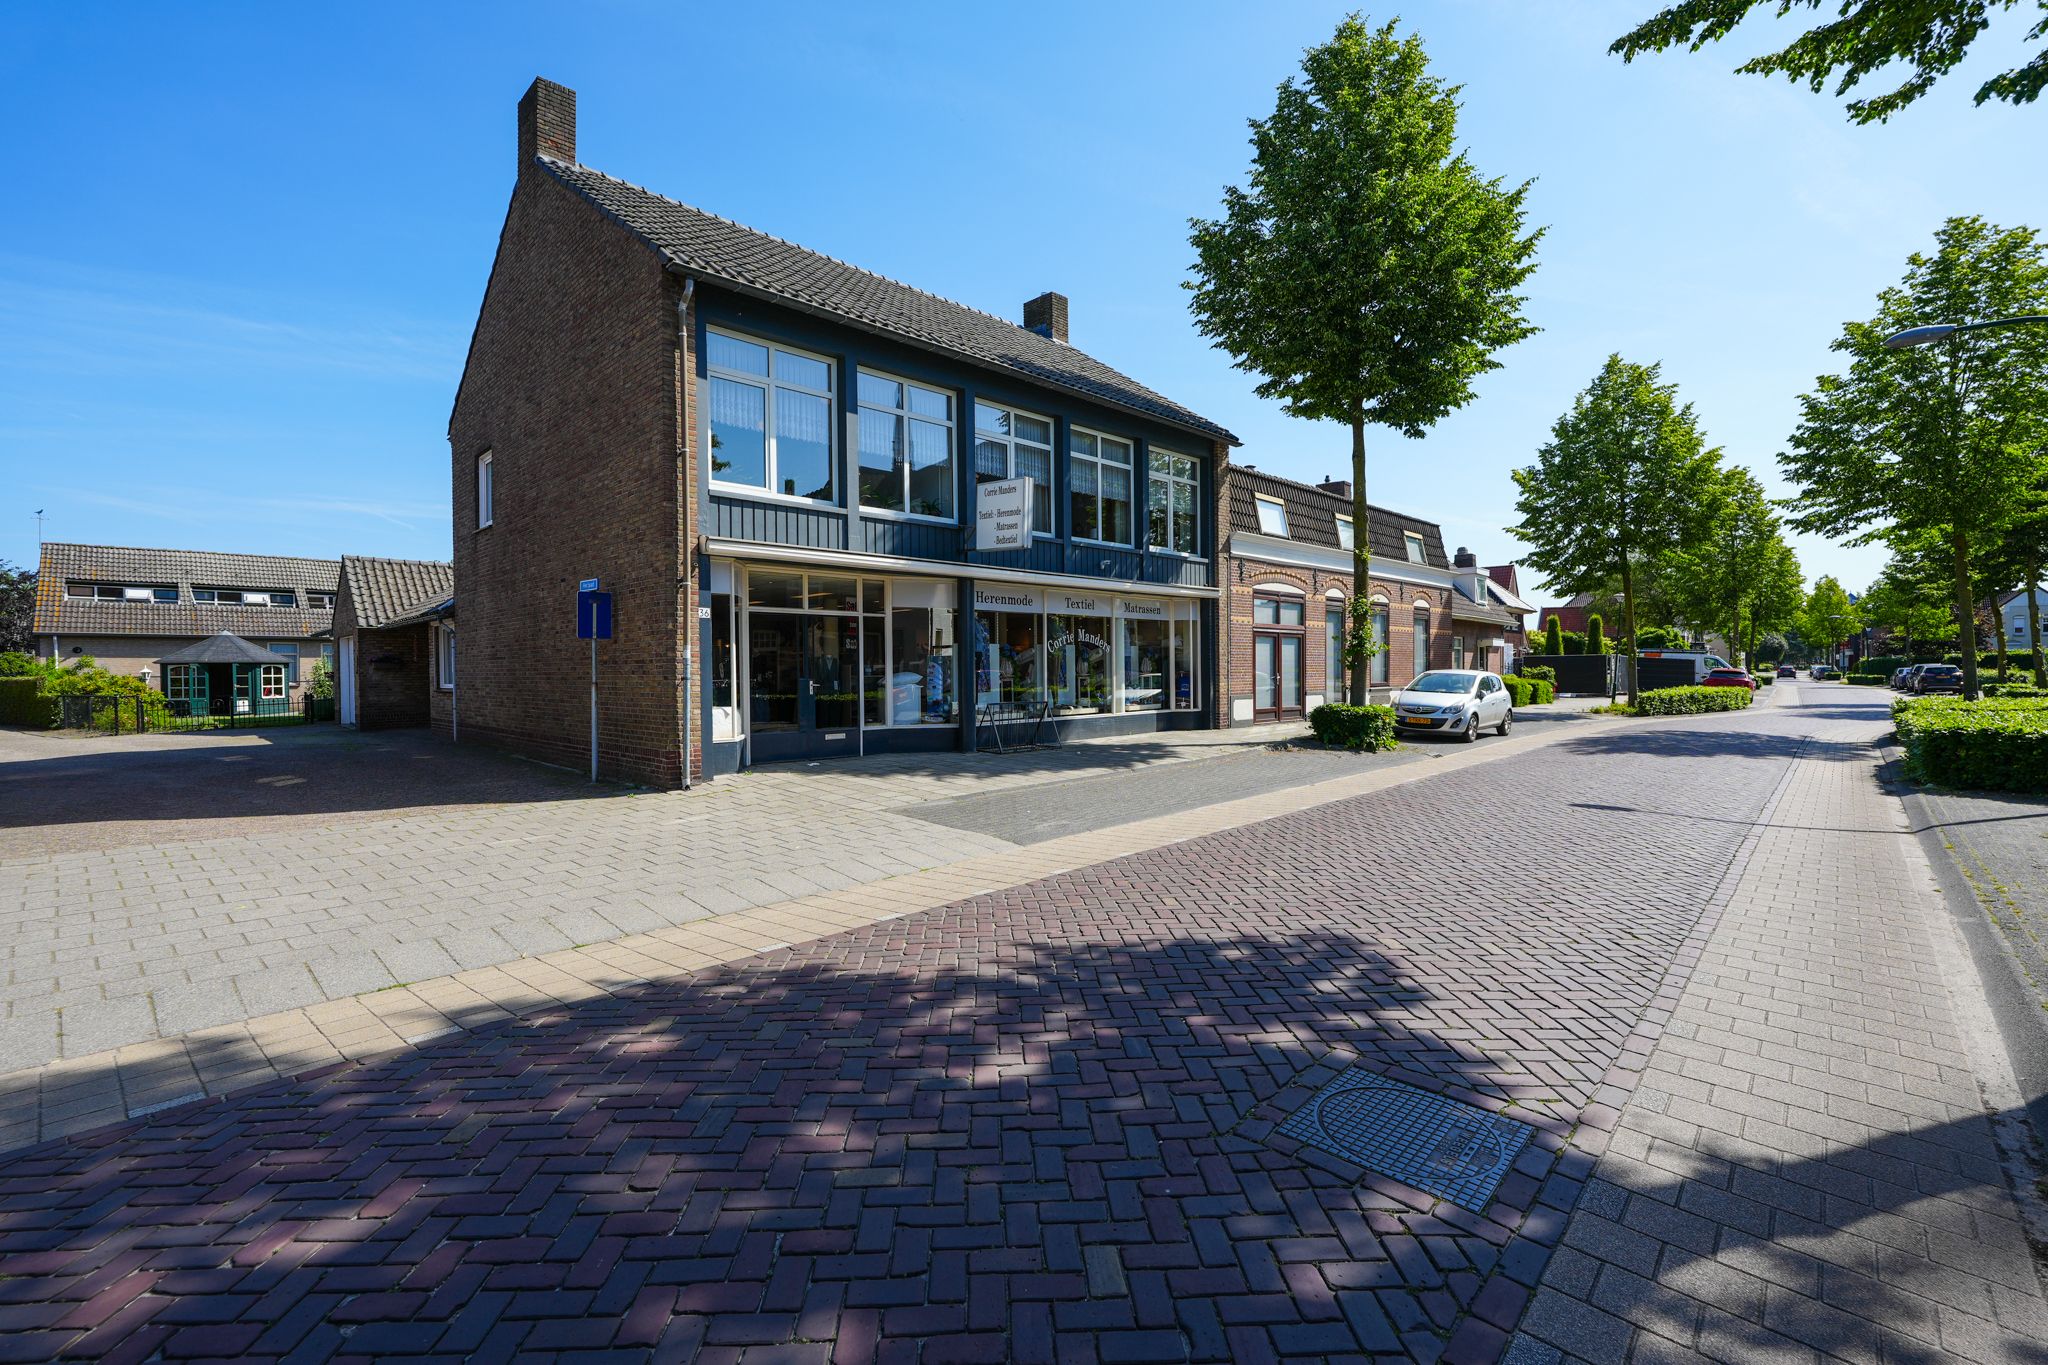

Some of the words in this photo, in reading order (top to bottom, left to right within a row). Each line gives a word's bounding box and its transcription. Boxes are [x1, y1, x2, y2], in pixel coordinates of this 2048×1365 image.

[984, 487, 998, 497] Corrie
[999, 485, 1017, 495] Manders
[996, 507, 1022, 518] Herenmode
[976, 590, 1033, 607] Herenmode
[1065, 597, 1095, 610] Textiel
[1124, 602, 1161, 615] Matrassen
[1047, 630, 1074, 653] Corrie
[1078, 628, 1111, 653] Manders
